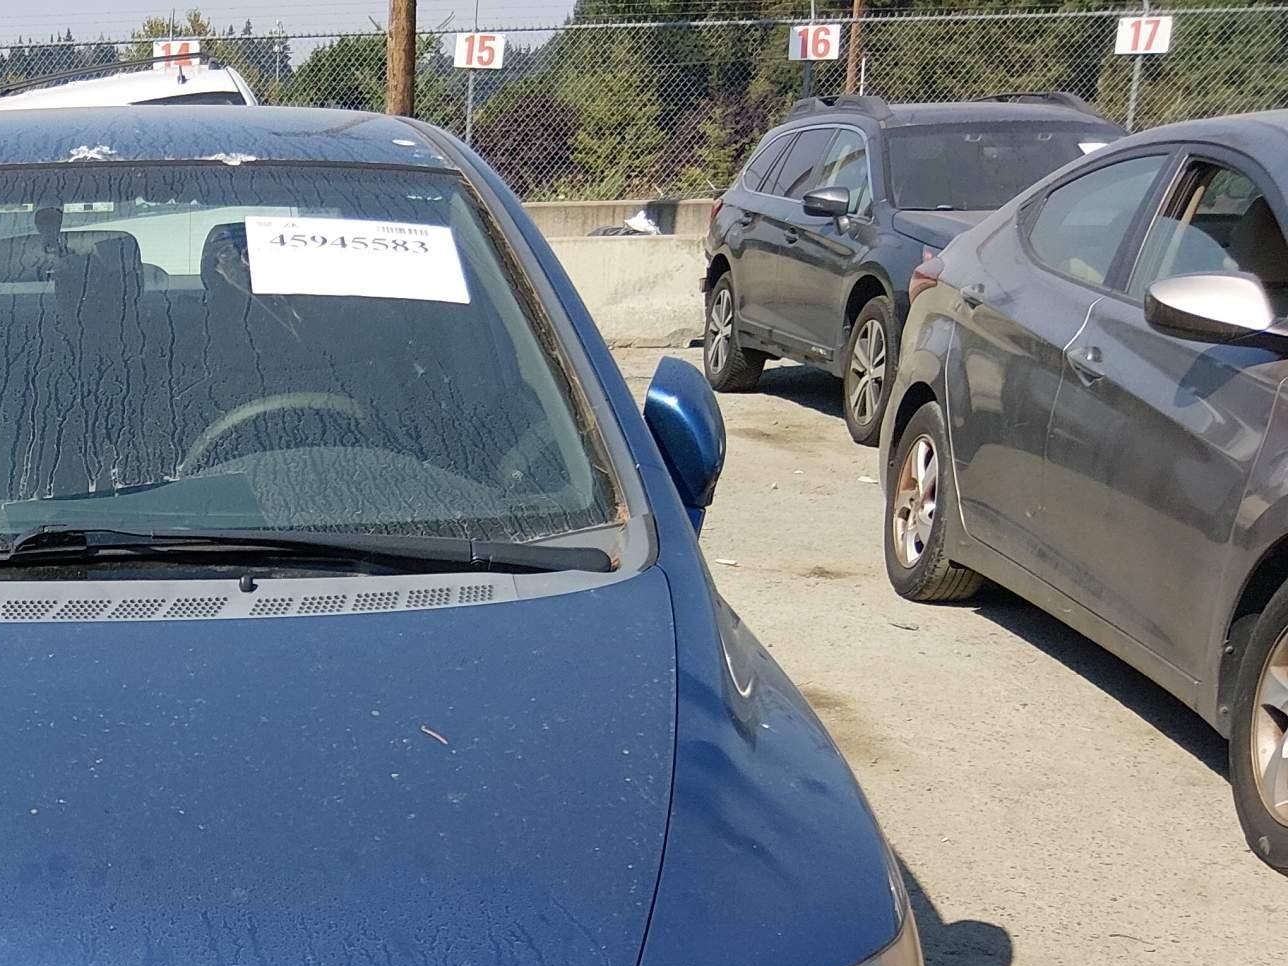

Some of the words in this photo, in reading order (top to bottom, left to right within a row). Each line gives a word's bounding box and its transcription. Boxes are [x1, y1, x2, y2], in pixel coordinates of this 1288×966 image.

[464, 35, 497, 66] 15
[797, 26, 832, 59] 16
[1129, 19, 1161, 51] 17
[161, 42, 193, 67] 14
[269, 233, 429, 254] 45945583
